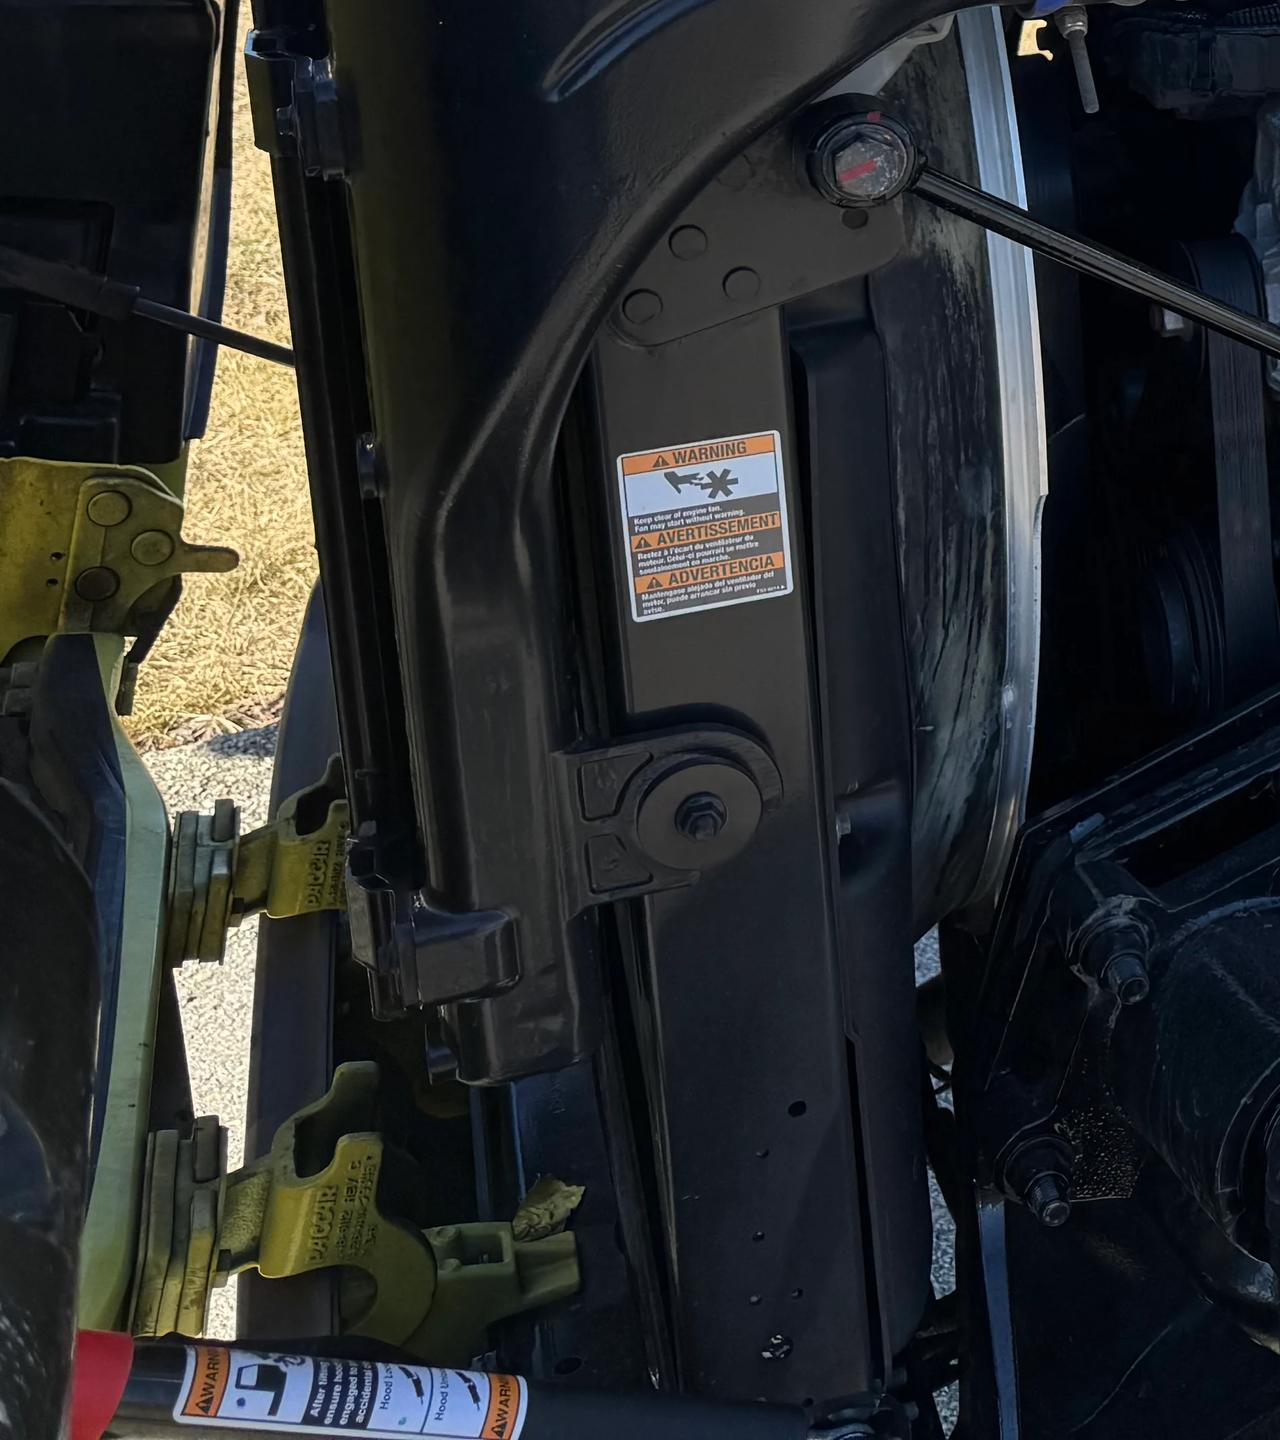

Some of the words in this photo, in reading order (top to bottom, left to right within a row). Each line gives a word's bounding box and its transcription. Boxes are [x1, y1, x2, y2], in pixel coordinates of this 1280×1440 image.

[672, 441, 747, 465] WARNING
[634, 516, 653, 526] Keep
[654, 512, 672, 522] clear
[674, 510, 681, 518] of
[683, 507, 707, 518] engine
[708, 505, 722, 513] fan.
[635, 525, 649, 533] Fan
[650, 523, 665, 532] may
[668, 519, 685, 528] start
[686, 514, 713, 525] without
[715, 509, 745, 521] warning.
[657, 513, 778, 546] AVERTISSEMENT
[638, 551, 663, 561] Restez
[695, 541, 704, 550] du
[669, 556, 775, 586] ADVERTENCIA
[714, 580, 726, 590] del
[763, 571, 775, 579] del
[721, 585, 733, 593] sin
[308, 841, 331, 907] PACCAR
[309, 1185, 339, 1262] PACCAR
[200, 1350, 220, 1398] WARN
[310, 1388, 326, 1417] After
[324, 1384, 342, 1425] ensure
[340, 1377, 359, 1425] engaged
[356, 1370, 373, 1424] accidental
[379, 1381, 393, 1410] Hood
[434, 1392, 449, 1421] Hood
[496, 1380, 511, 1423] WARN
